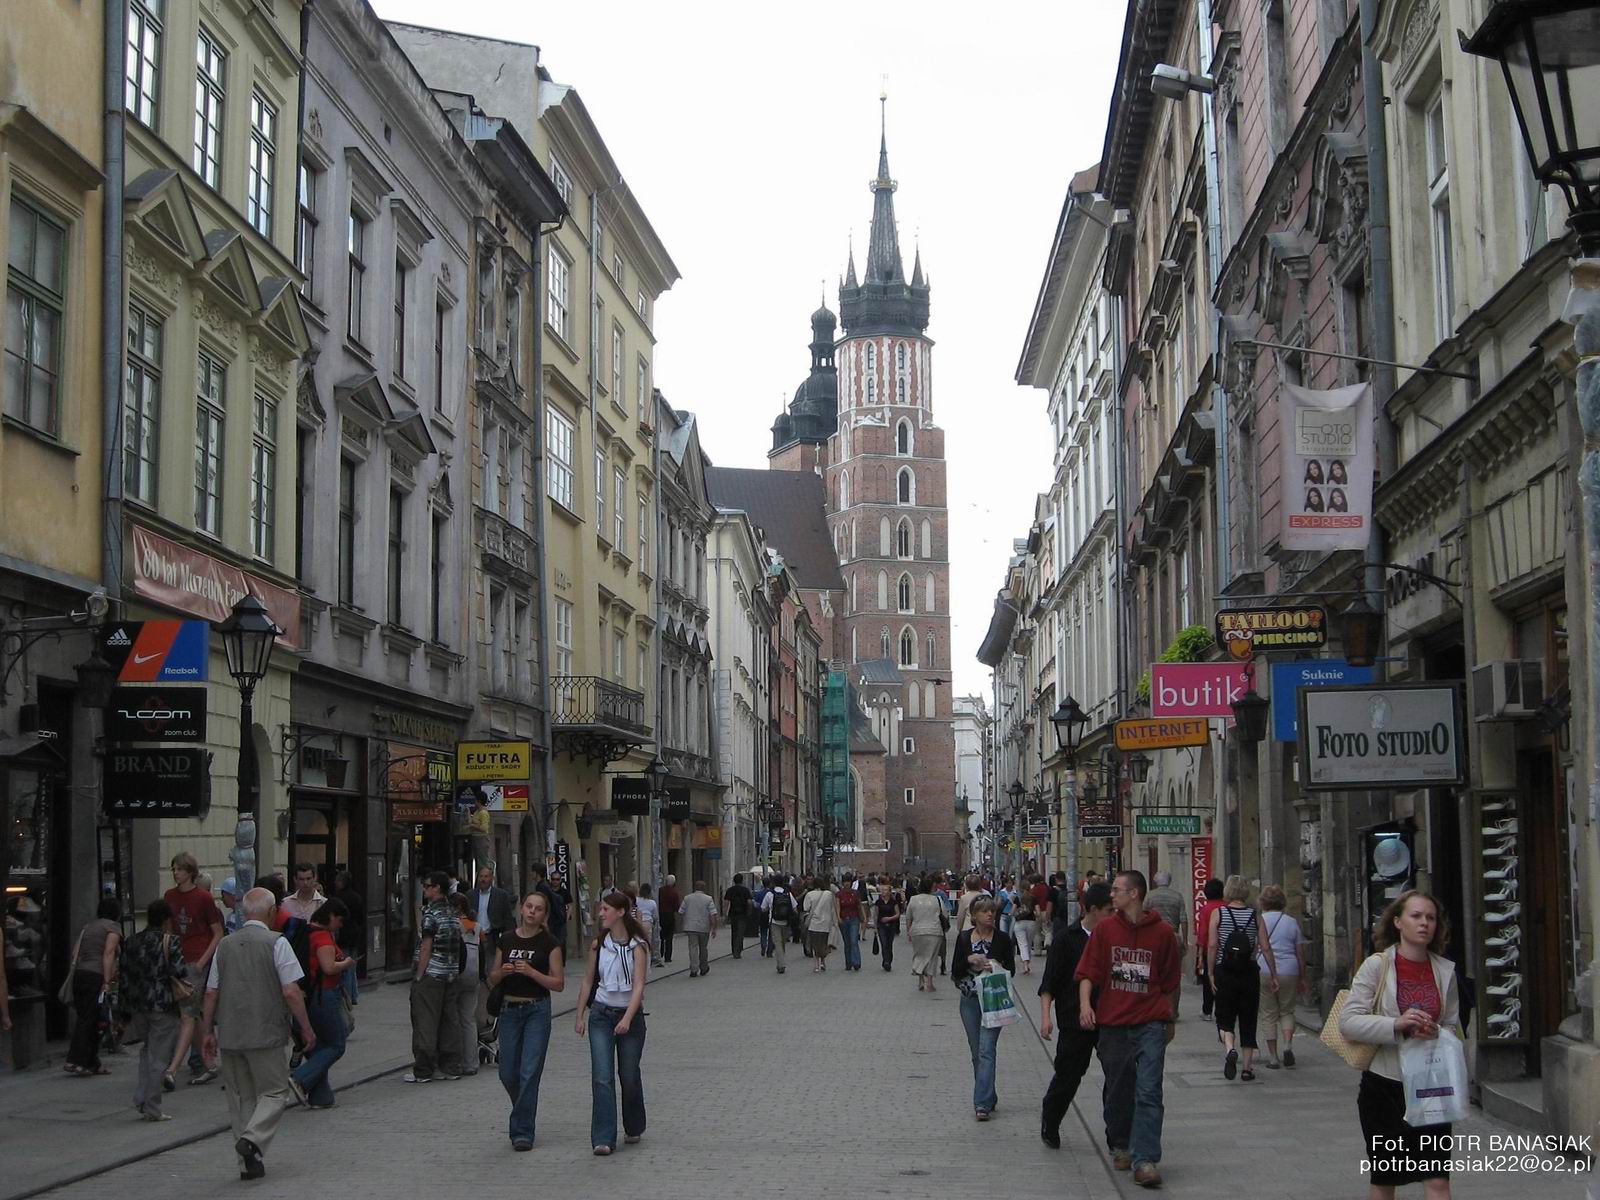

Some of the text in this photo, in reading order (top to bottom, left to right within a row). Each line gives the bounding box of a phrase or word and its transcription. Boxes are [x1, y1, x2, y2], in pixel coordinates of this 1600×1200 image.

[1301, 433, 1353, 445] STUDIO
[1292, 516, 1362, 528] EXPRESS
[143, 548, 160, 580] 80
[162, 555, 177, 587] lat
[180, 563, 222, 604] Muzeum
[164, 667, 199, 675] Reebok
[1302, 669, 1344, 680] Suknie
[1119, 721, 1201, 740] INTERNET
[115, 756, 191, 772] BRAND
[466, 753, 521, 764] FUTRA
[1113, 947, 1152, 963] SMITHS
